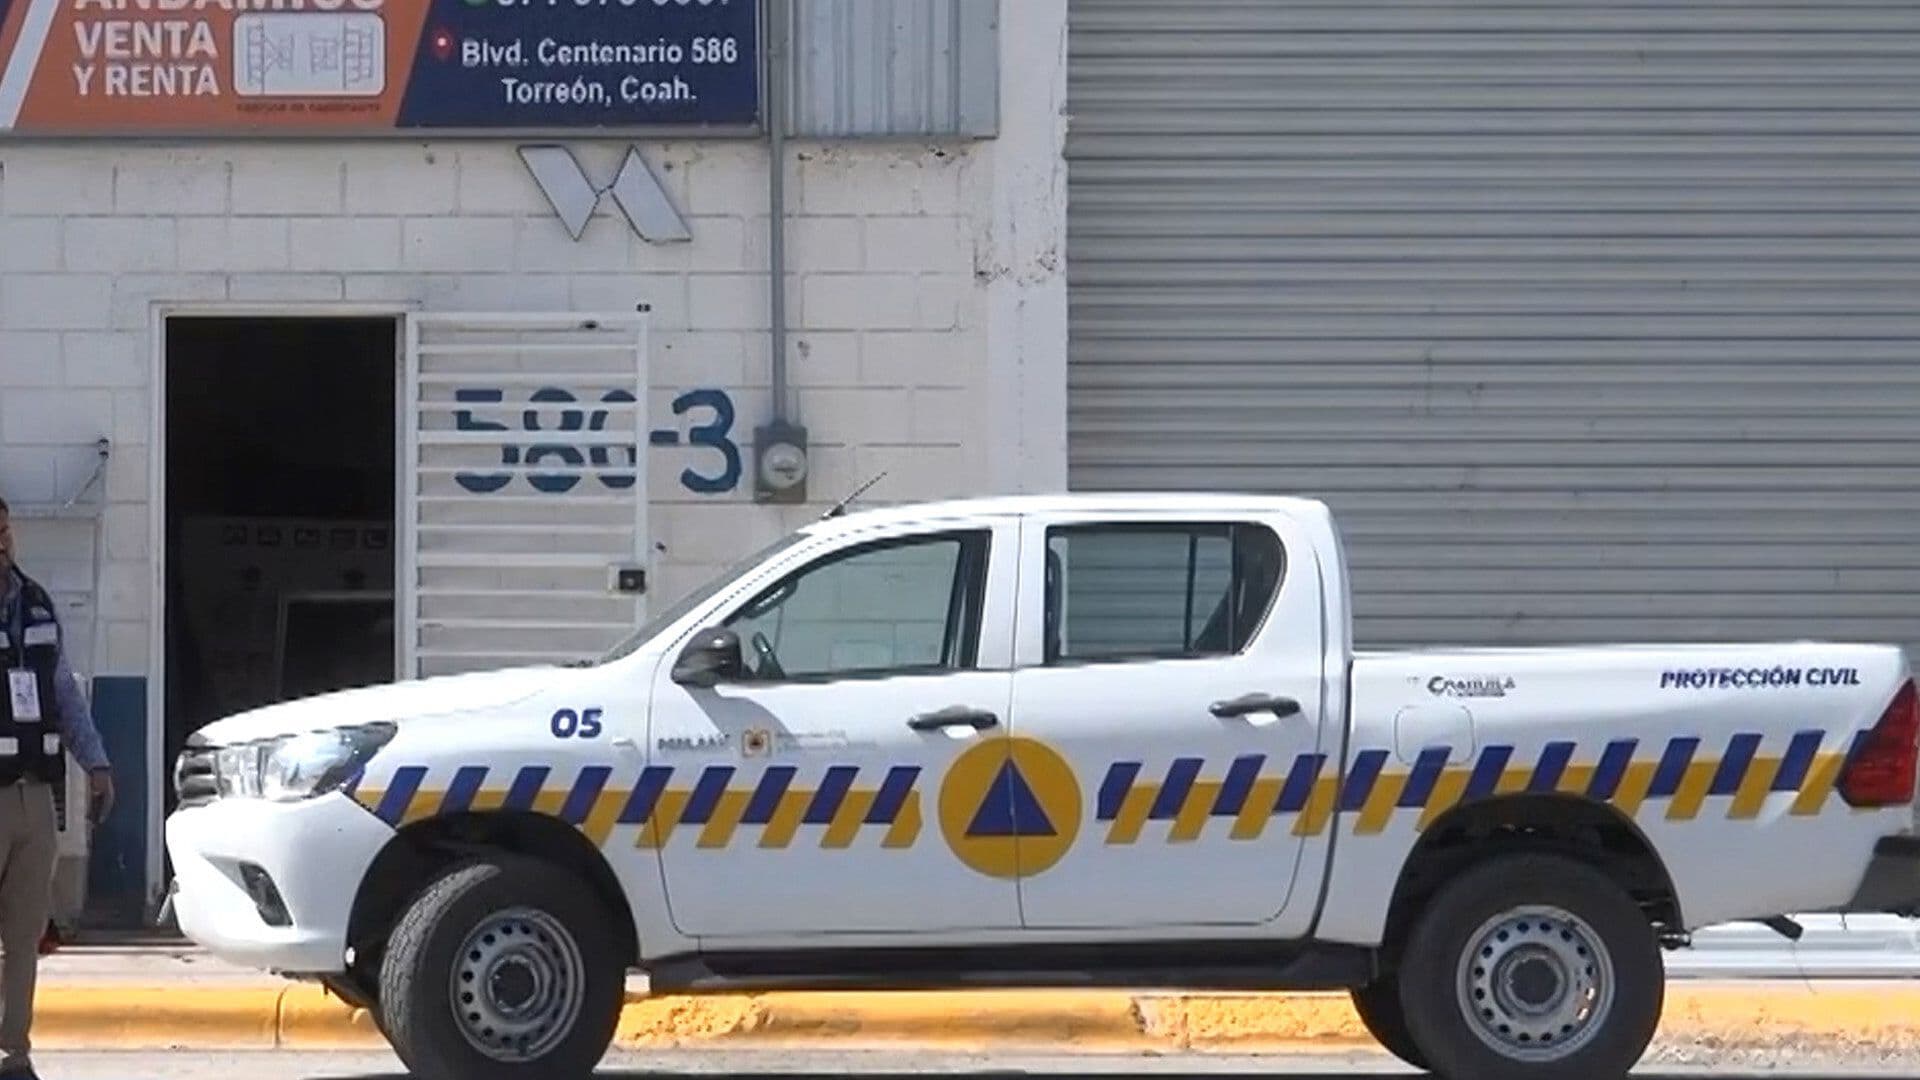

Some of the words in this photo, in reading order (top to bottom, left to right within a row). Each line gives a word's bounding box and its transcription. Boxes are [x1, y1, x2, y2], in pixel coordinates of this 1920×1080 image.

[74, 20, 219, 59] VENTA
[461, 38, 529, 67] Blvd.
[538, 38, 683, 64] Centenario
[691, 38, 738, 64] 586
[72, 64, 96, 96] Y
[105, 64, 220, 96] RENTA
[501, 77, 612, 106] Torreón,
[620, 76, 697, 103] Coah.
[1660, 666, 1801, 689] PROTECCIÓN
[1806, 668, 1860, 685] CIVIL
[550, 708, 603, 738] 05
